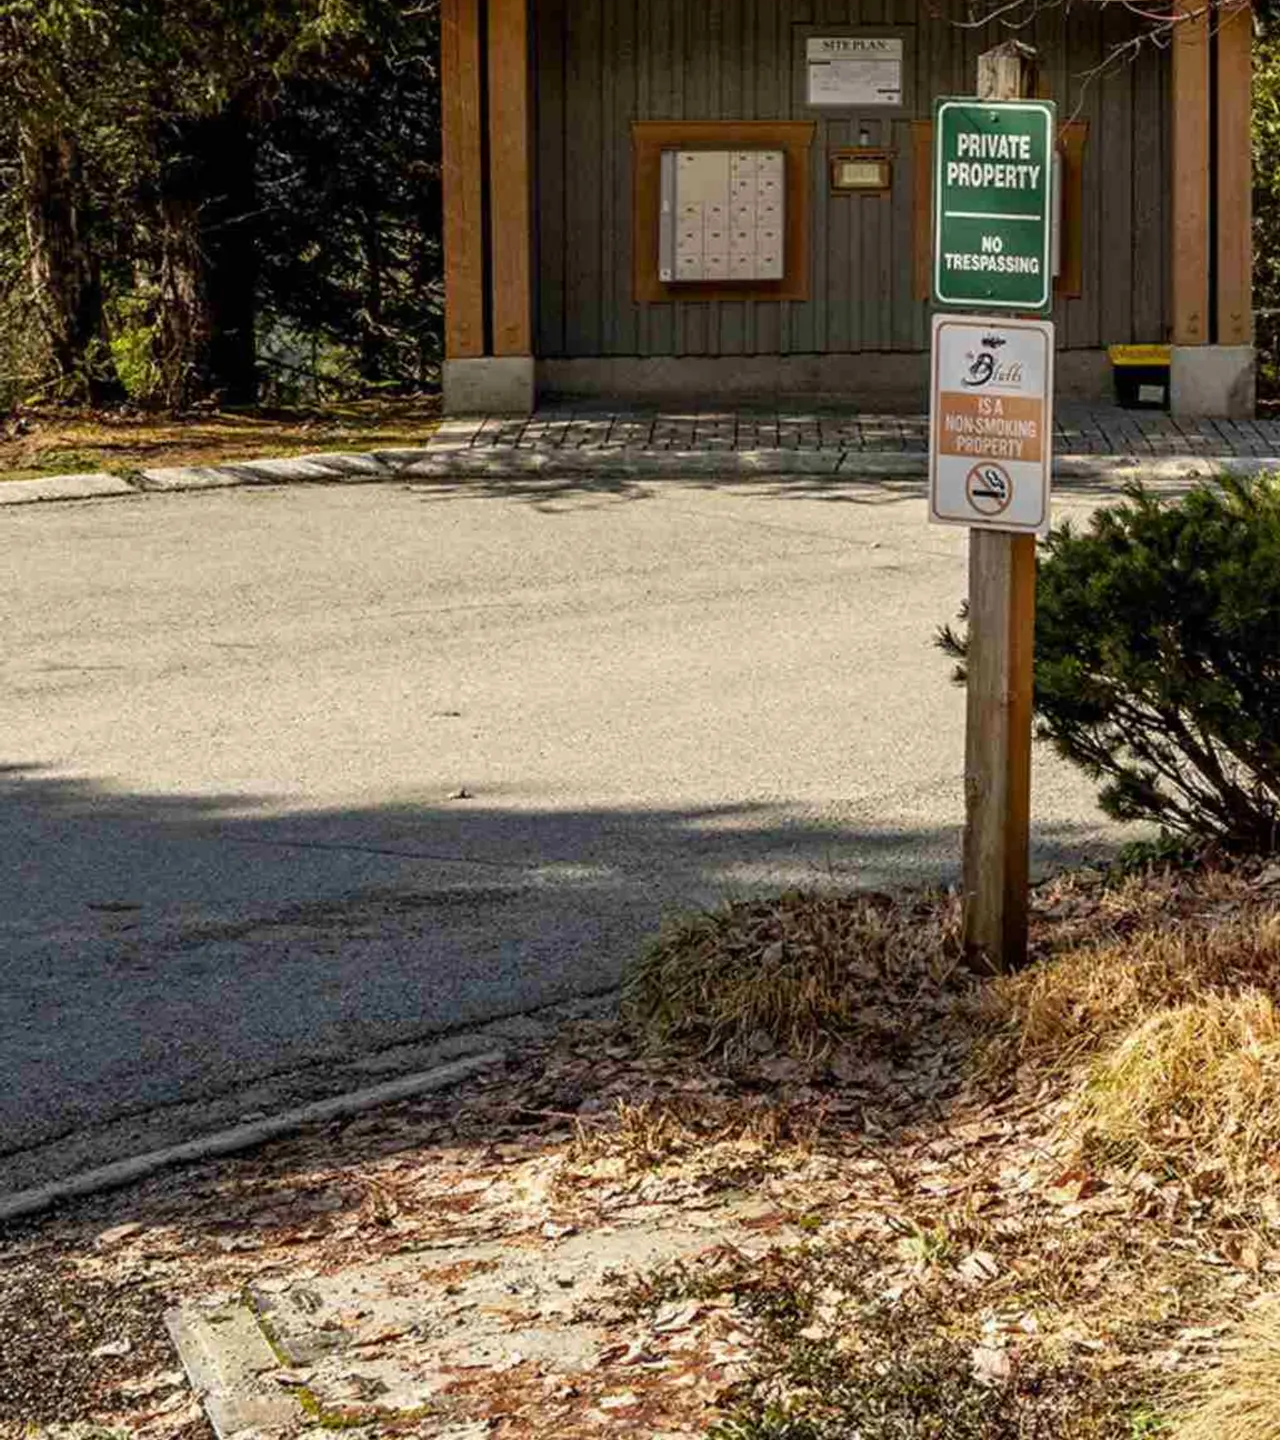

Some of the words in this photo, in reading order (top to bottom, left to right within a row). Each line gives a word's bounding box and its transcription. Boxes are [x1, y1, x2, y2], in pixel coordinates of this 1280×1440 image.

[852, 40, 886, 51] PLAN
[957, 133, 1031, 159] PRIVATE
[947, 161, 1040, 190] PROPERTY
[981, 235, 1003, 253] NO
[944, 253, 1040, 275] TRESPASSING
[978, 398, 993, 416] IS
[995, 399, 1004, 416] A
[956, 435, 1024, 457] PROPERTY
